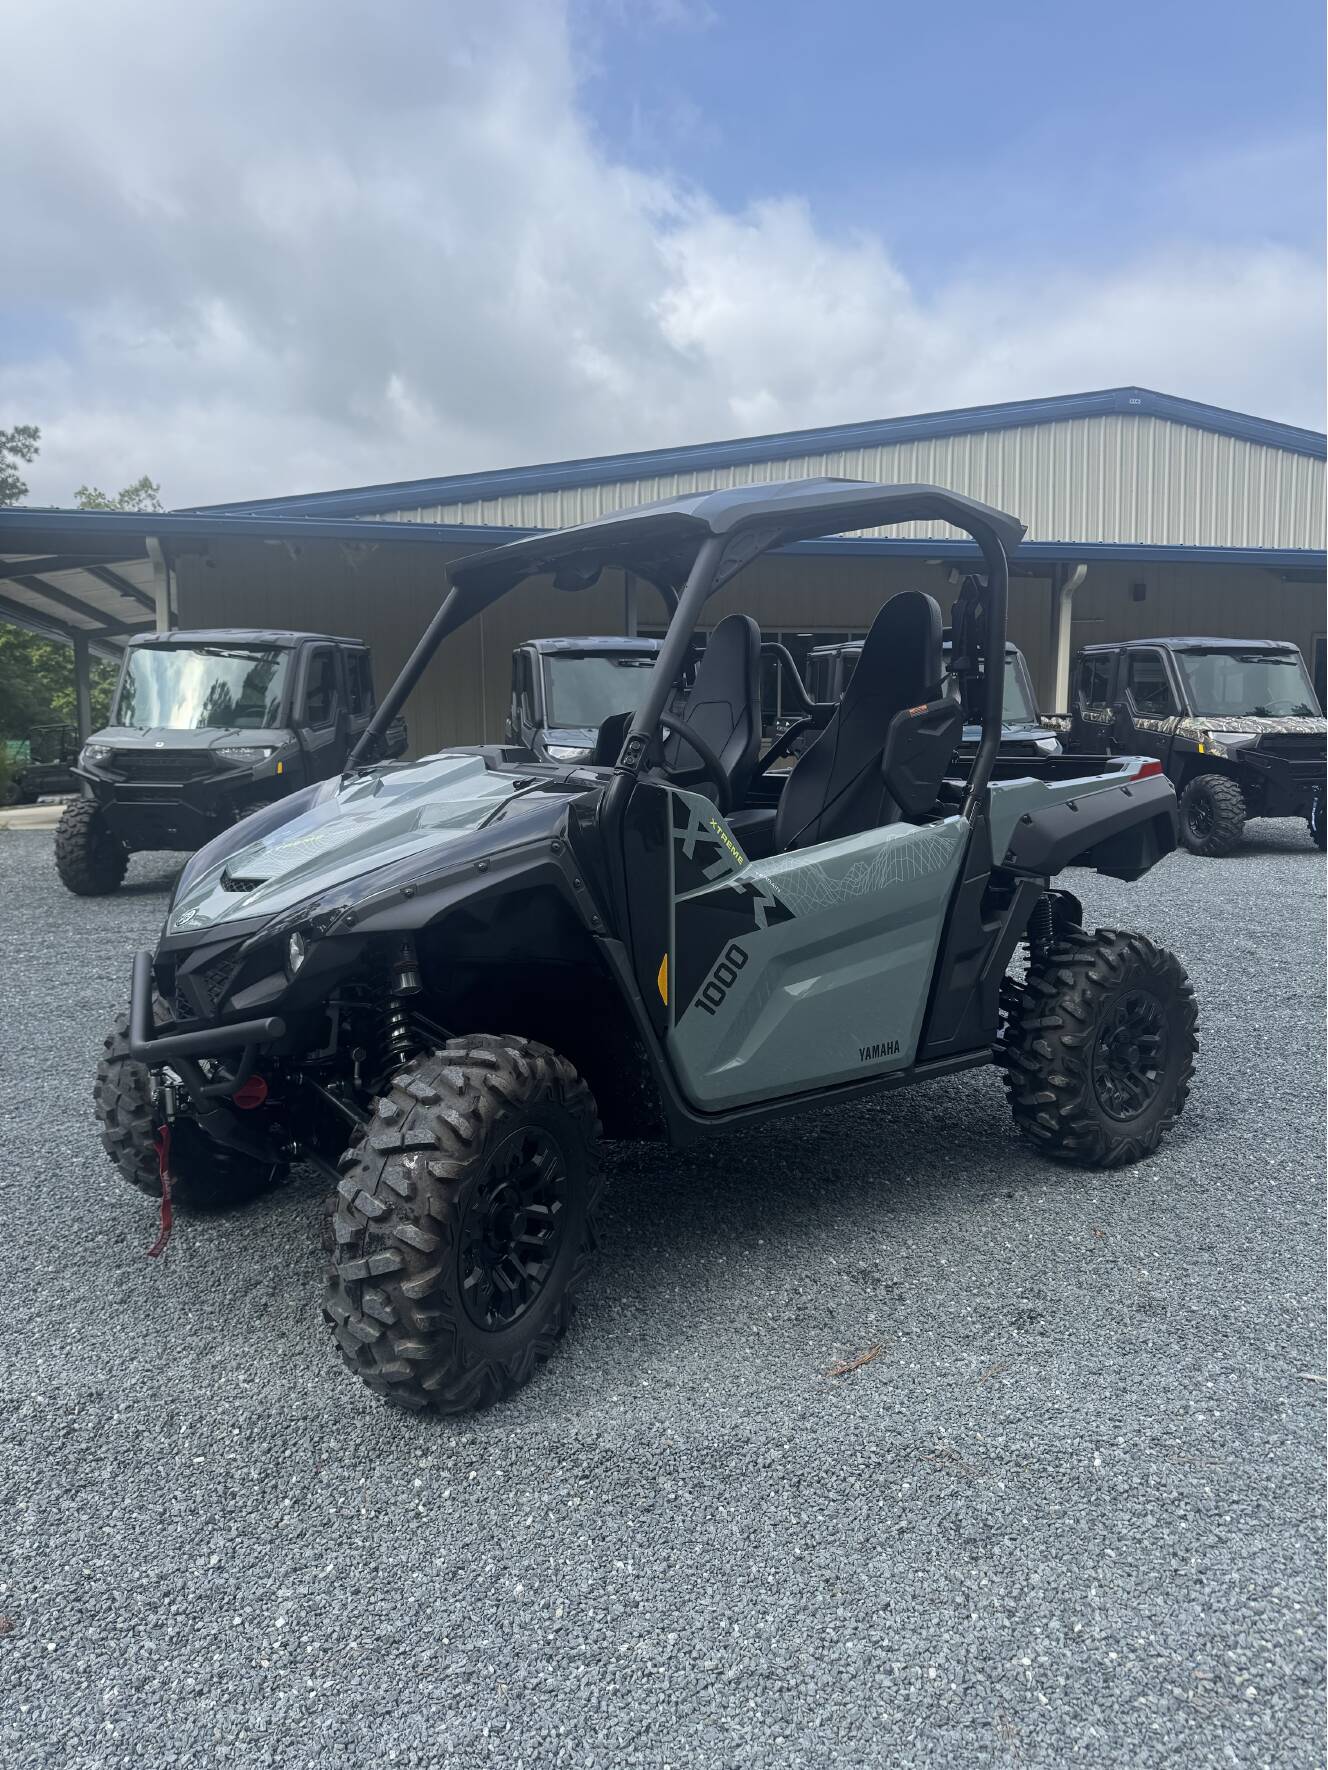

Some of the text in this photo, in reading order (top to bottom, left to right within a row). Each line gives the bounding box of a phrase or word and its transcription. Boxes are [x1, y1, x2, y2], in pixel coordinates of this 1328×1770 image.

[709, 818, 744, 865] XTREME
[694, 943, 749, 1016] 1000
[859, 1040, 900, 1062] YAMAHA
